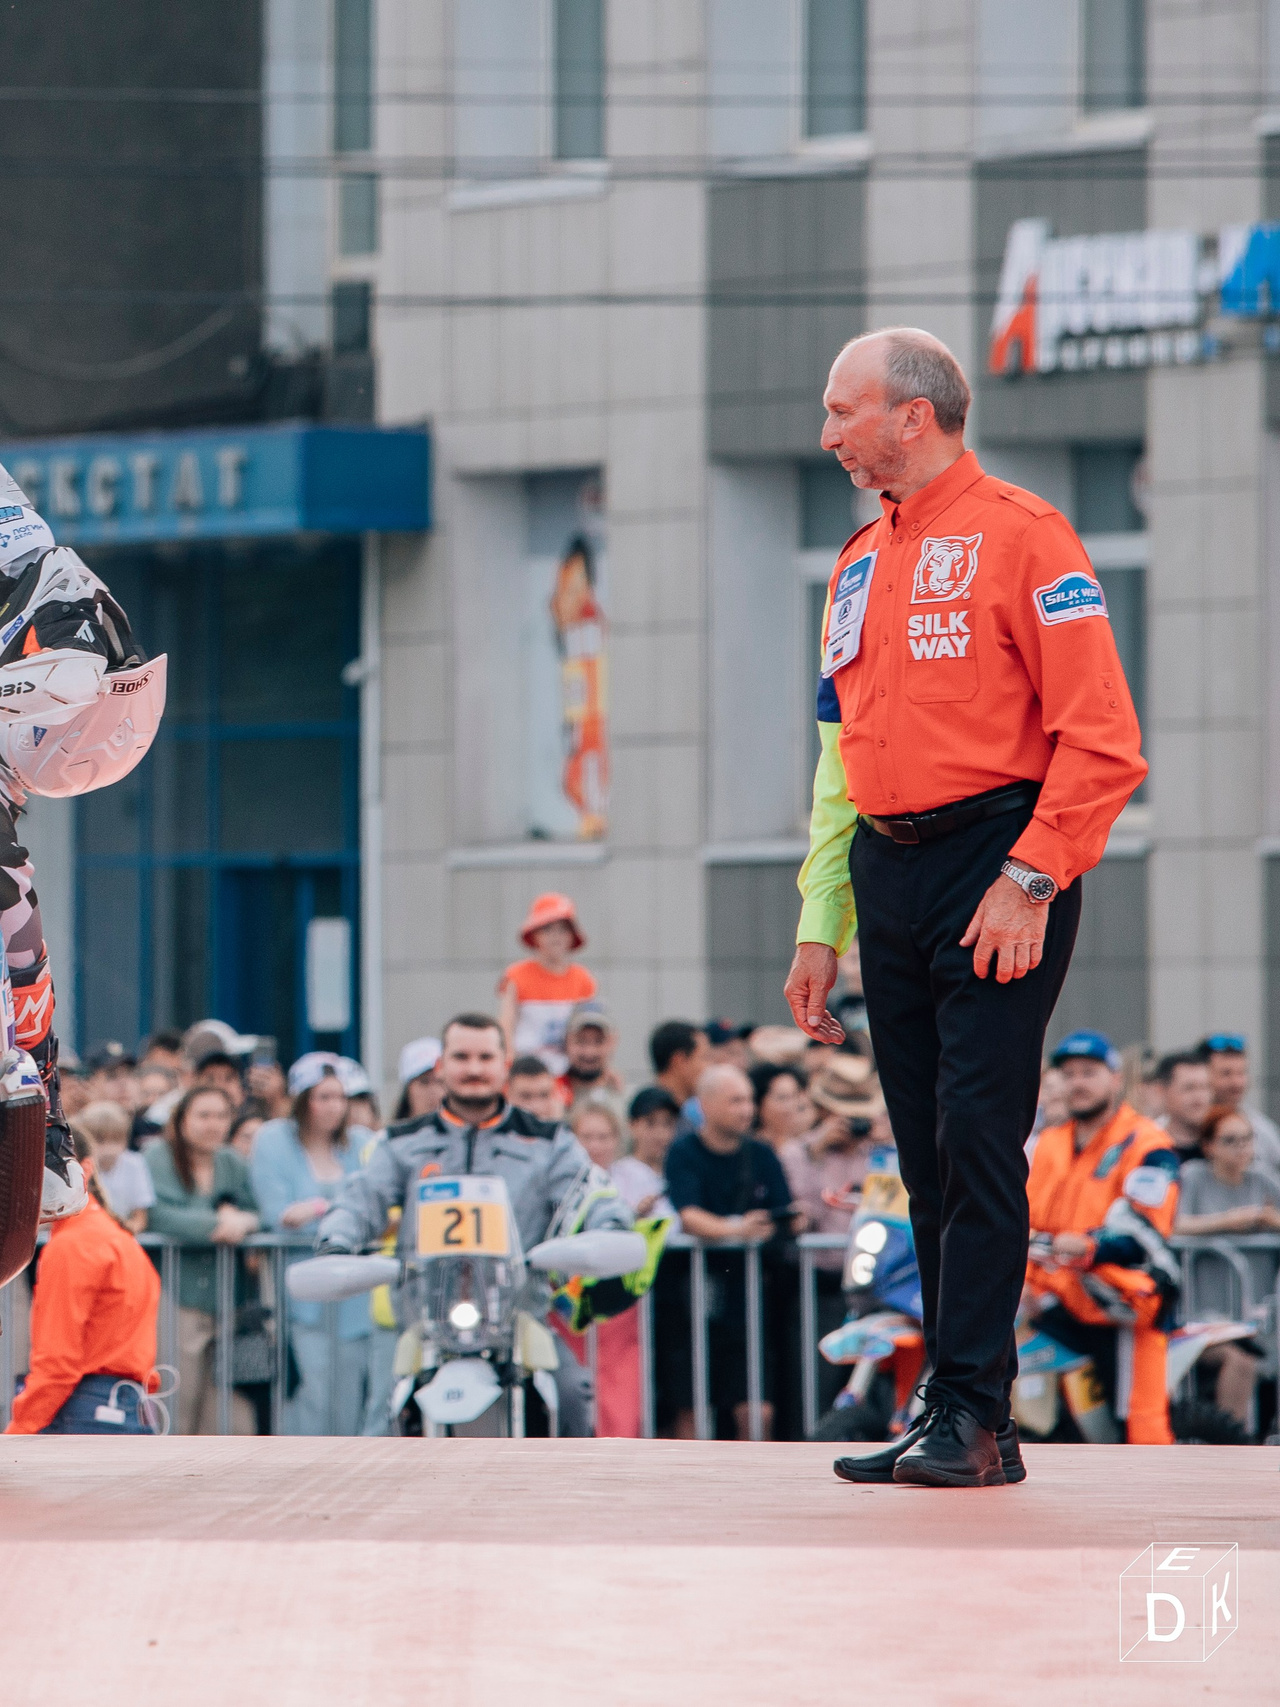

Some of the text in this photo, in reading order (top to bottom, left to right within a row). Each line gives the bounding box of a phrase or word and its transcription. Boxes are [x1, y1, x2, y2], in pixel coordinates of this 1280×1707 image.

[13, 525, 44, 536] ЛОГИН
[1045, 588, 1081, 606] SILK
[907, 610, 971, 637] SILK
[908, 635, 971, 661] WAY
[112, 673, 150, 693] SHOEI
[443, 1207, 482, 1245] 21
